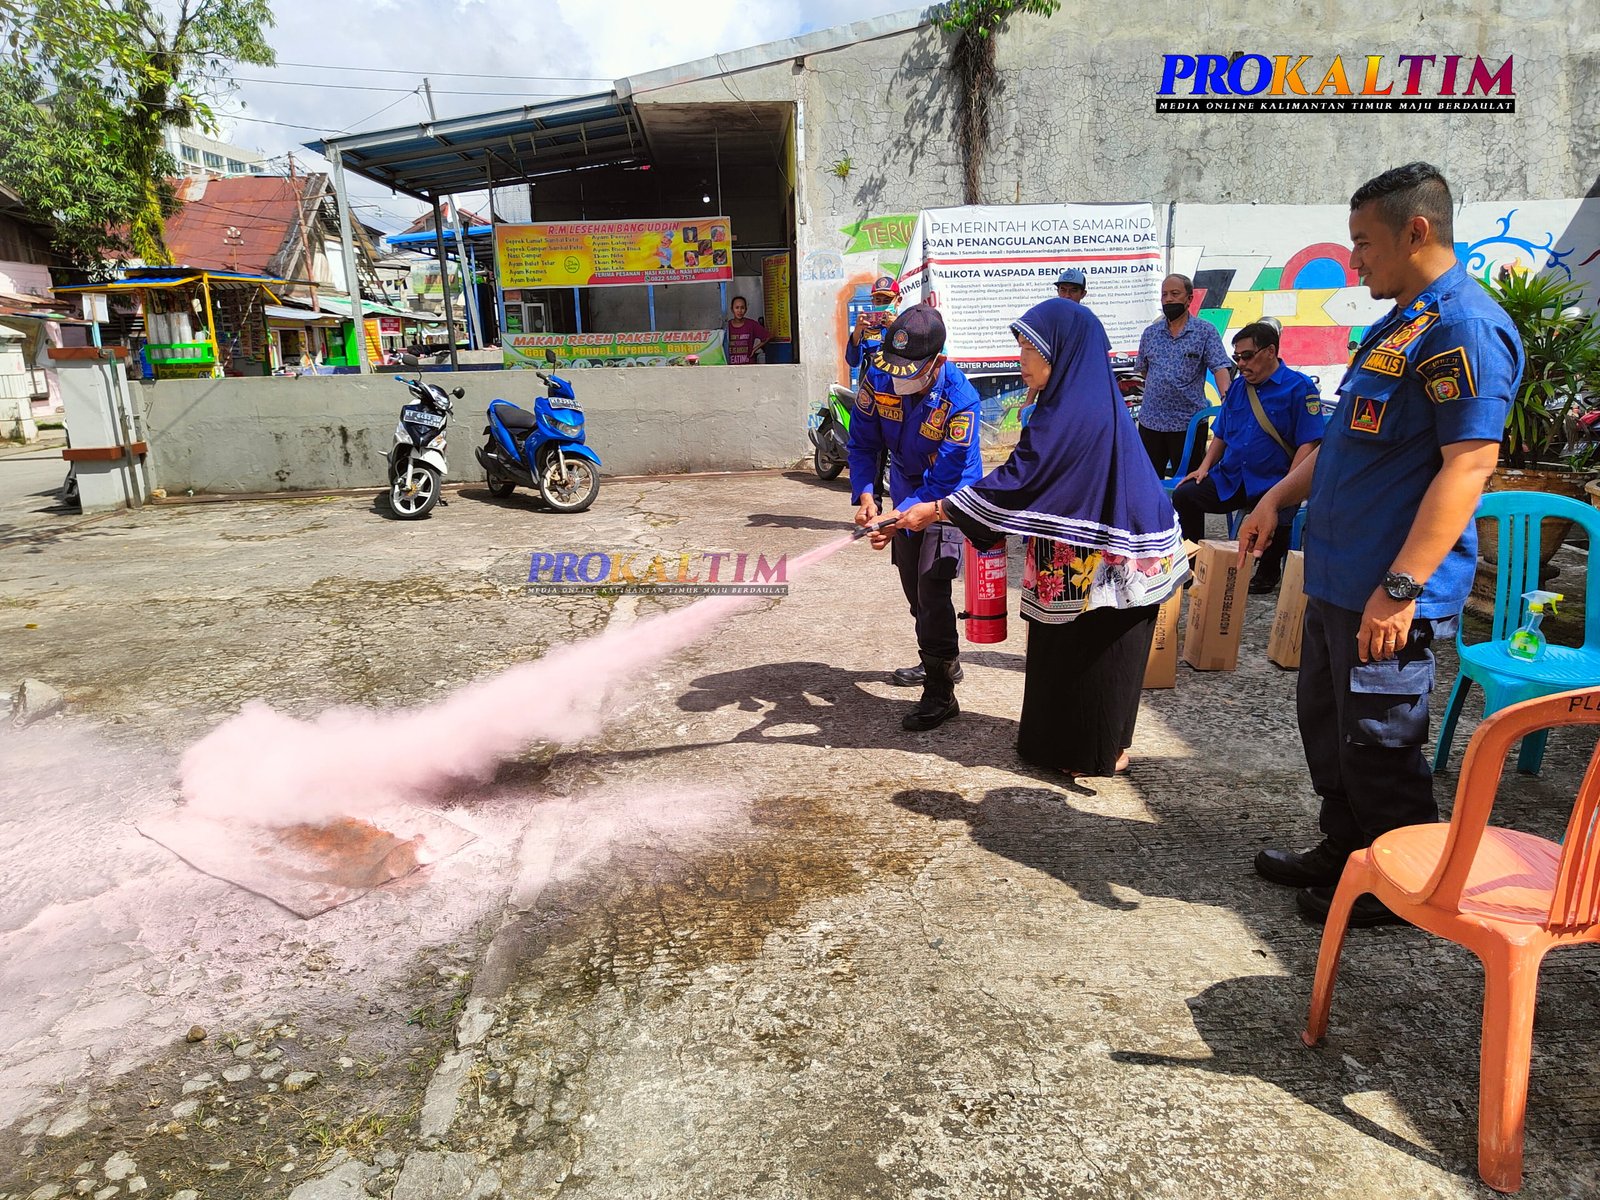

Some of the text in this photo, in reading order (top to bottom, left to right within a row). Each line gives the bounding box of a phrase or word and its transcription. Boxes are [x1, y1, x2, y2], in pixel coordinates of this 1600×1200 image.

[569, 224, 614, 234] LESEHAN
[616, 223, 645, 233] BANG
[647, 222, 680, 232] UDDIN
[931, 221, 1027, 234] PEMERINTAH
[1031, 219, 1069, 231] KOTA
[957, 235, 1070, 247] PENANGGULANGAN
[1073, 234, 1130, 244] BENCANA
[983, 268, 1036, 278] WASPADA
[1038, 266, 1088, 276] BENCA
[1090, 265, 1128, 275] BANJIR
[1130, 263, 1154, 273] DAN
[513, 331, 712, 347] MAKAN RECEH PAKET HEMAT
[667, 344, 702, 353] Bakar
